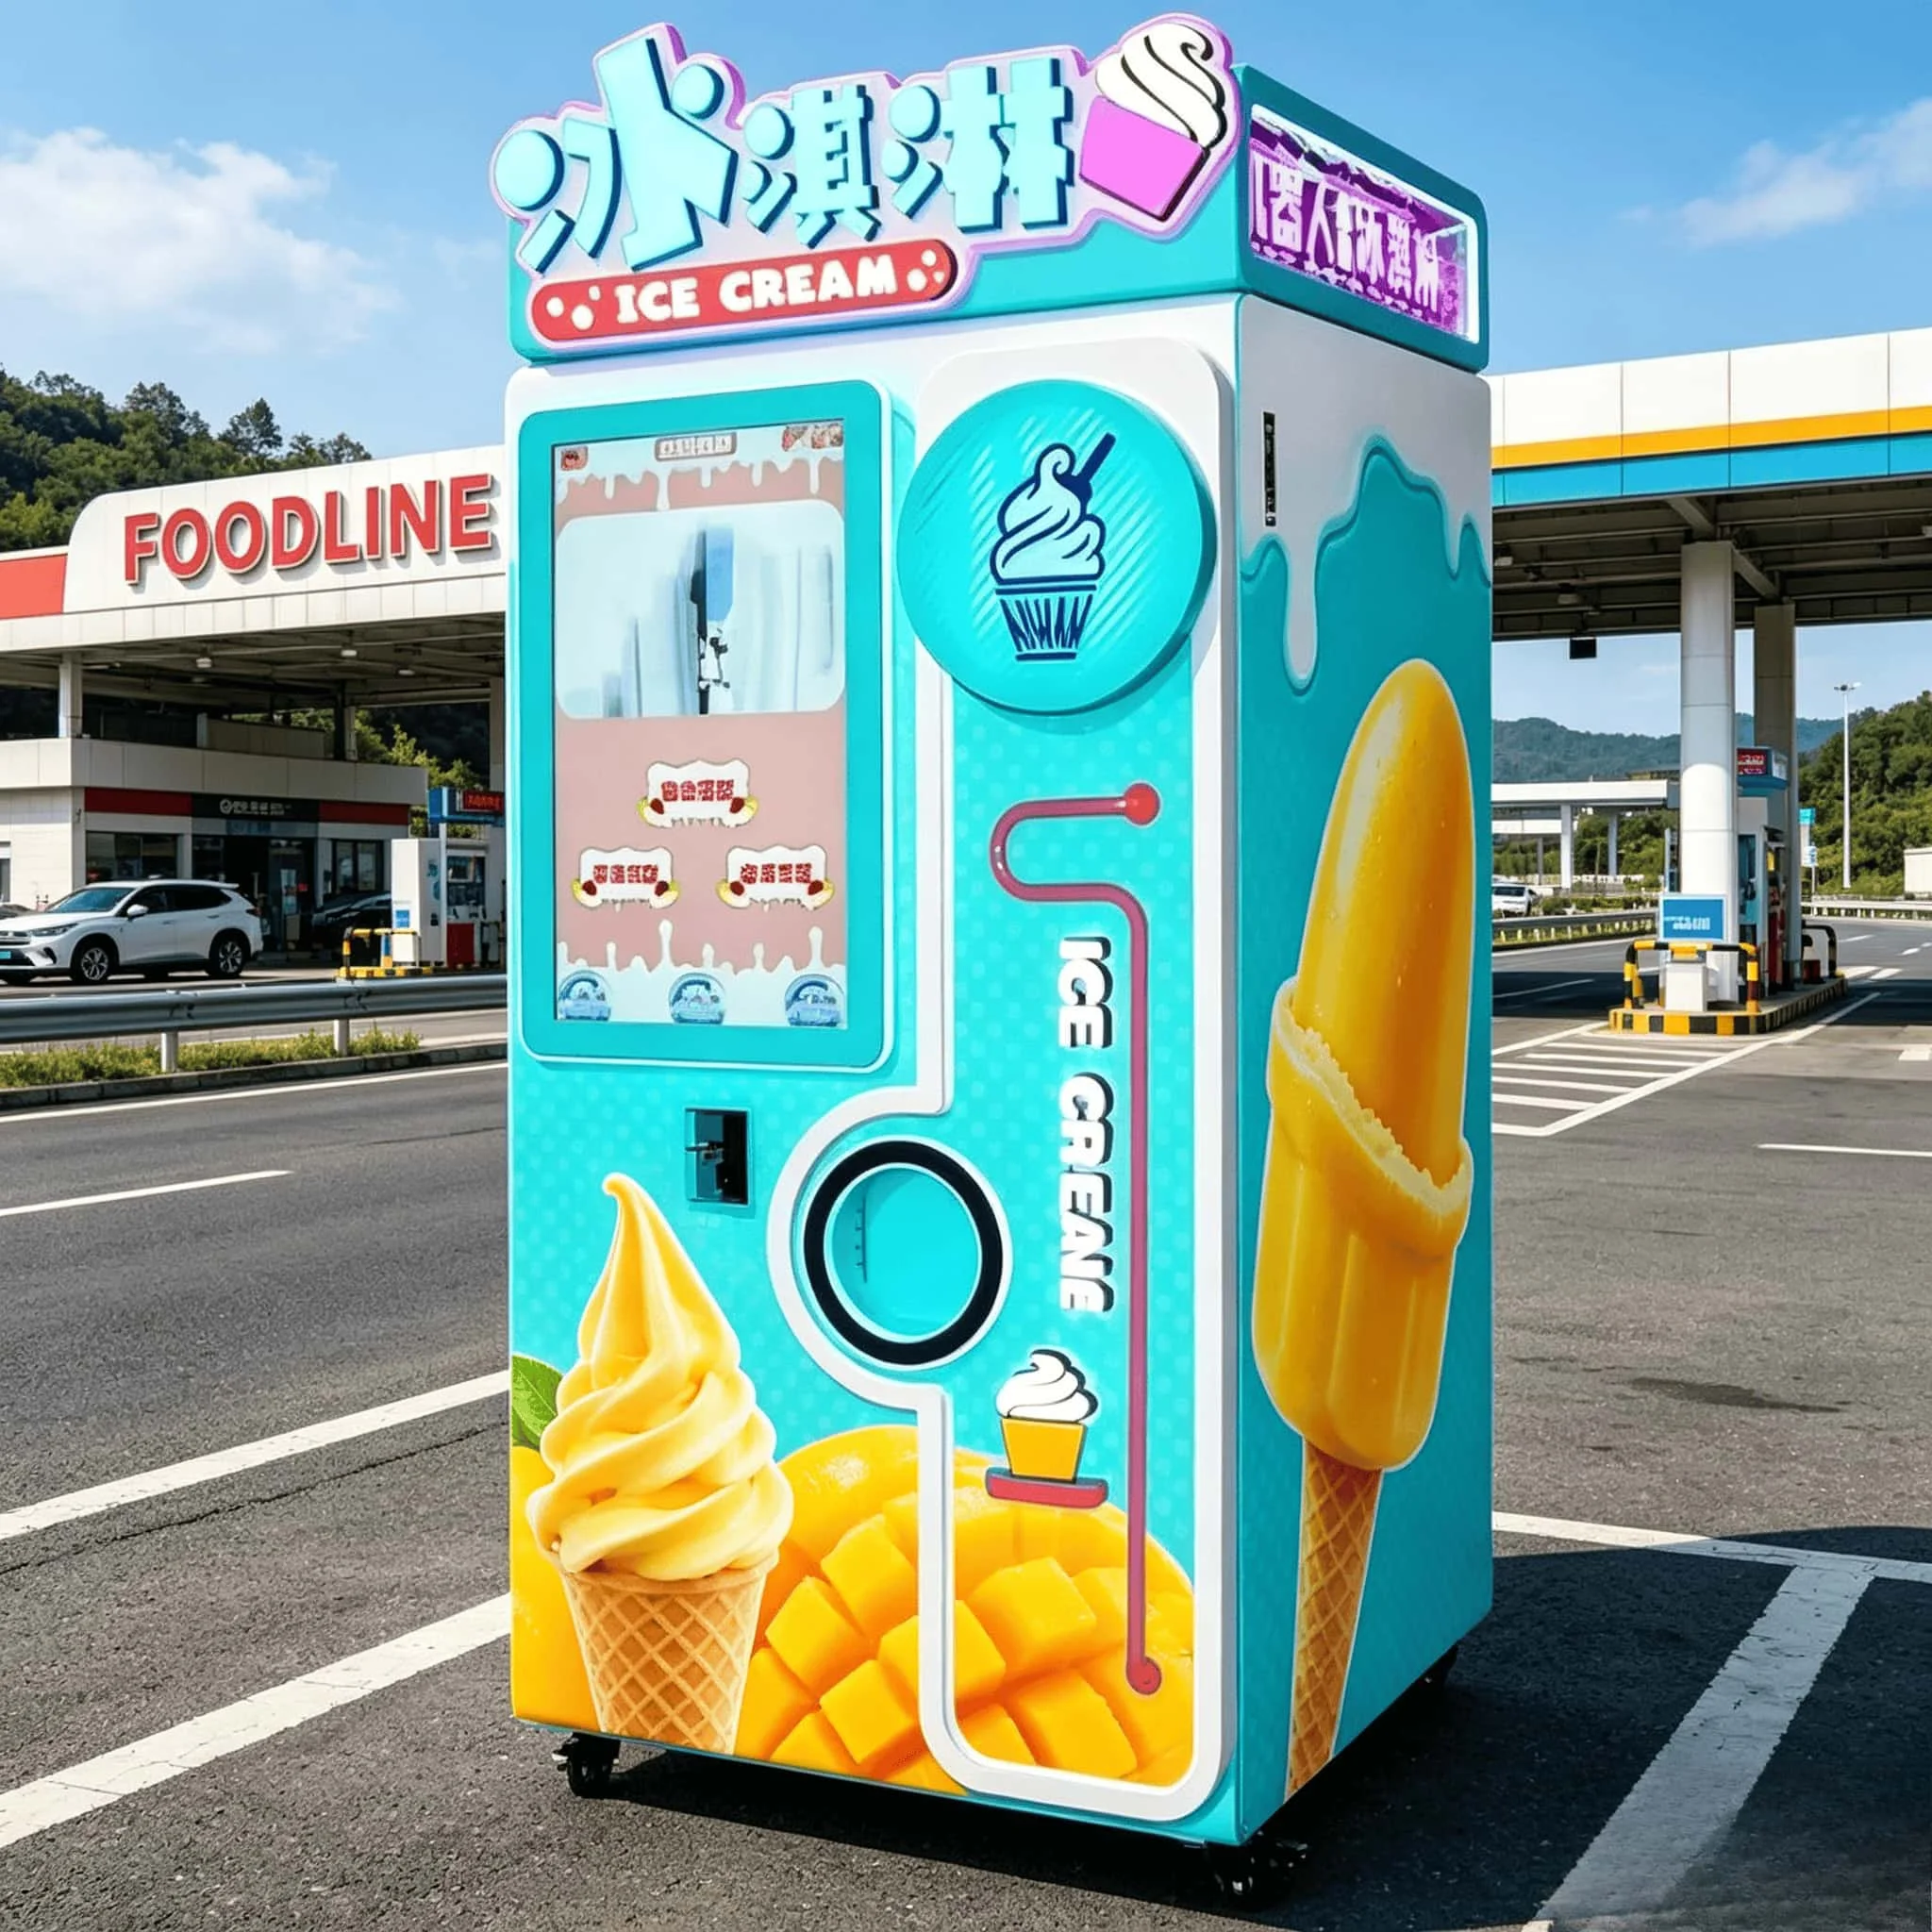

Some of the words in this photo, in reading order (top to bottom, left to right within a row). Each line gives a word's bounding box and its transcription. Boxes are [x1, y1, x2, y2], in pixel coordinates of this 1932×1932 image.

[493, 36, 1074, 273] 冰淇淋
[615, 277, 700, 325] ICE
[719, 255, 898, 309] CREAM
[124, 474, 494, 585] FOODLINE
[1058, 936, 1113, 1048] ICE
